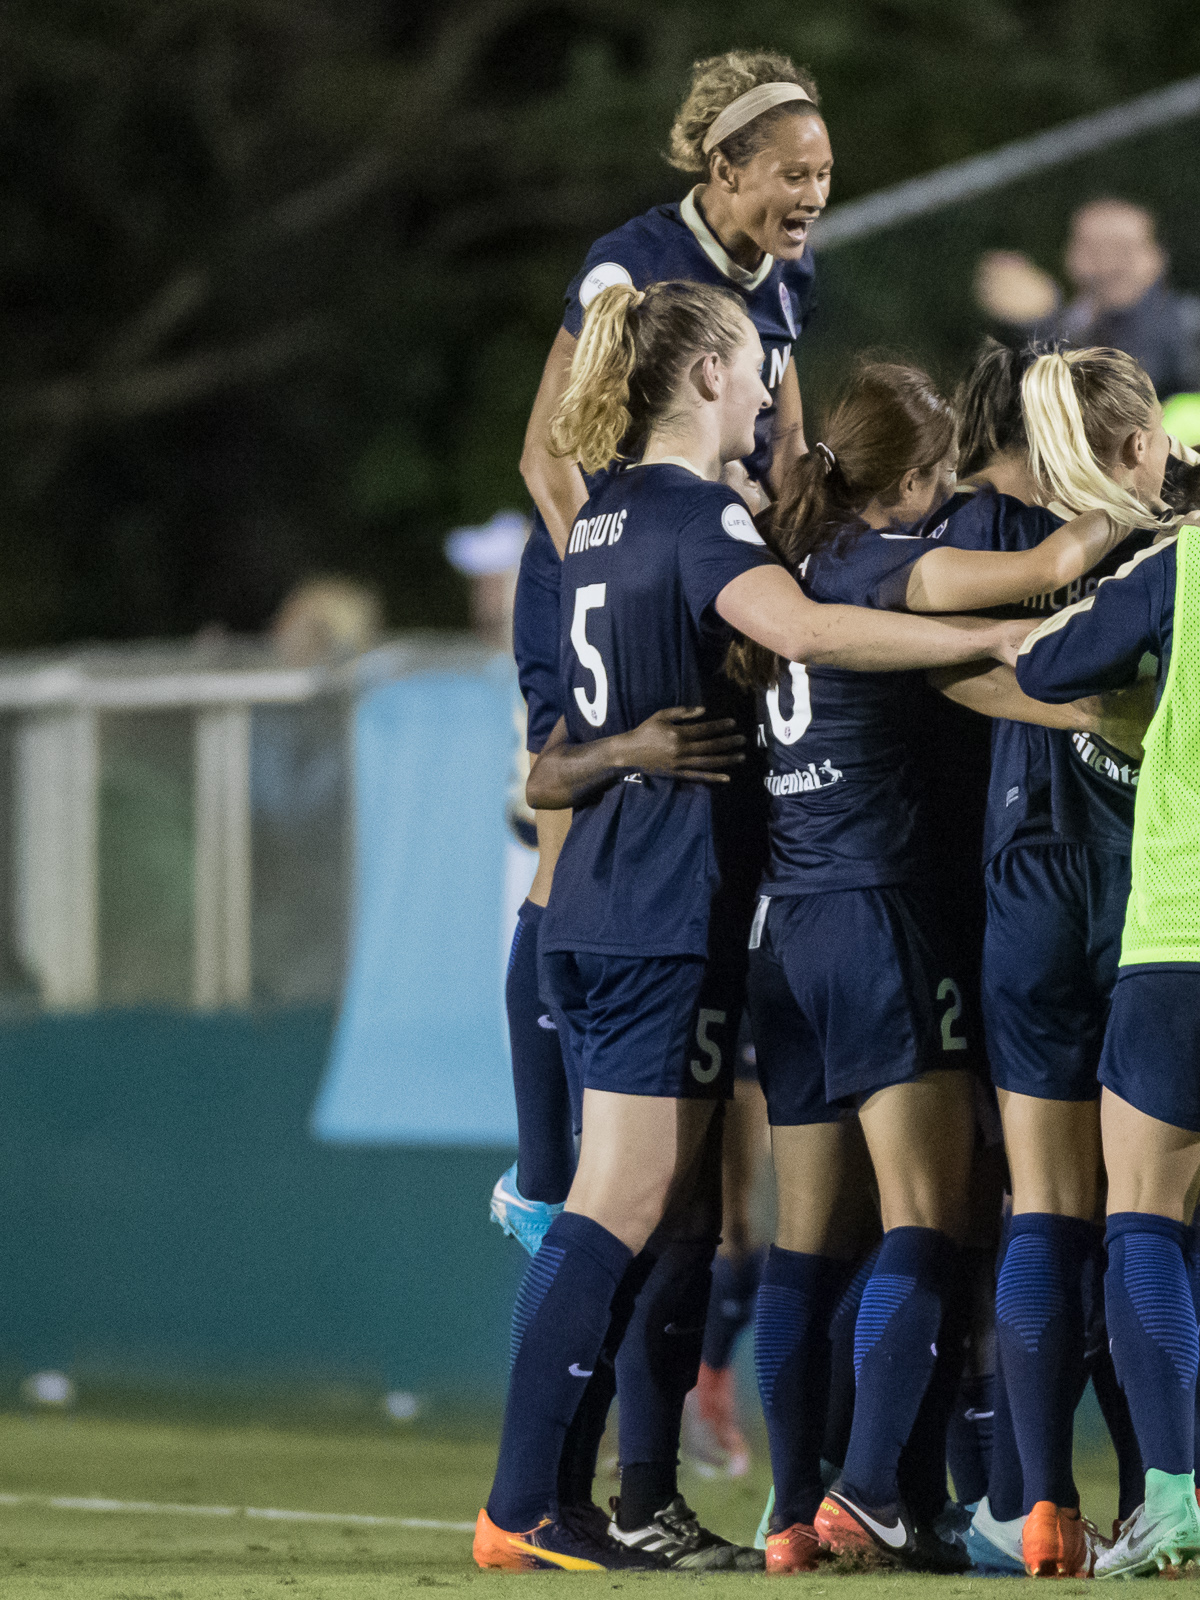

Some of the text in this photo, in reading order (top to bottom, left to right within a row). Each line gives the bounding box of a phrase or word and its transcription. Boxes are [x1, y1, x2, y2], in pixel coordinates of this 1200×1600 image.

[588, 275, 608, 290] LIFE
[570, 582, 608, 728] 5
[763, 762, 822, 796] inental
[690, 1007, 727, 1084] 5
[936, 977, 968, 1051] 2
